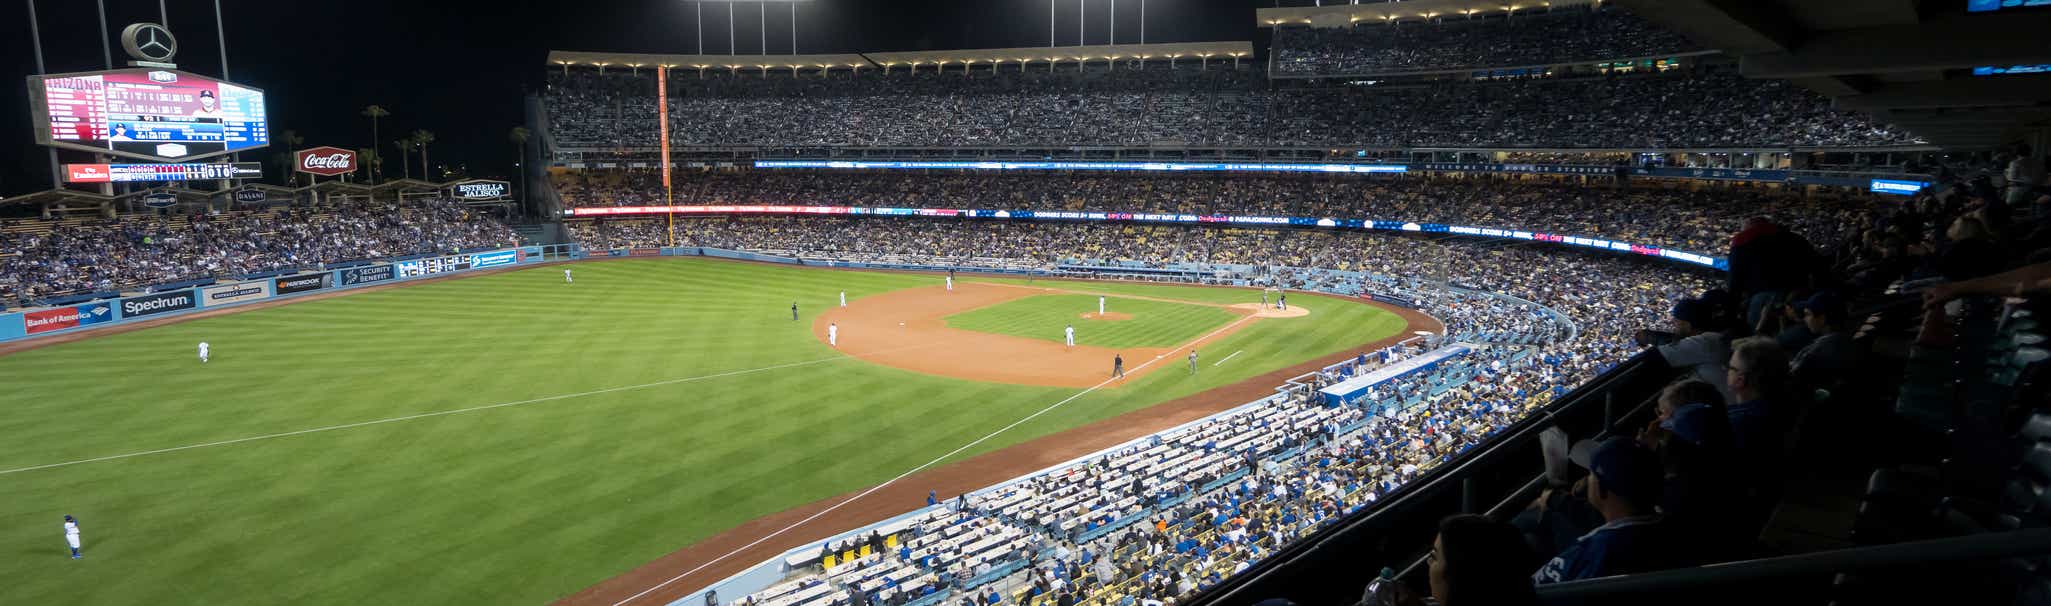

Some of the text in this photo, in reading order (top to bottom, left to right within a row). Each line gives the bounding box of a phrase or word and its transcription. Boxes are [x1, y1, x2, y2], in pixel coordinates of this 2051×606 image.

[304, 153, 351, 169] Coca-Cola
[208, 168, 215, 178] 0
[216, 168, 222, 178] 1
[223, 168, 230, 178] 0
[459, 183, 505, 192] ESTRELLA
[360, 266, 390, 275] SECURITY
[125, 296, 187, 315] Spectrum
[27, 312, 91, 327] Bank of America
